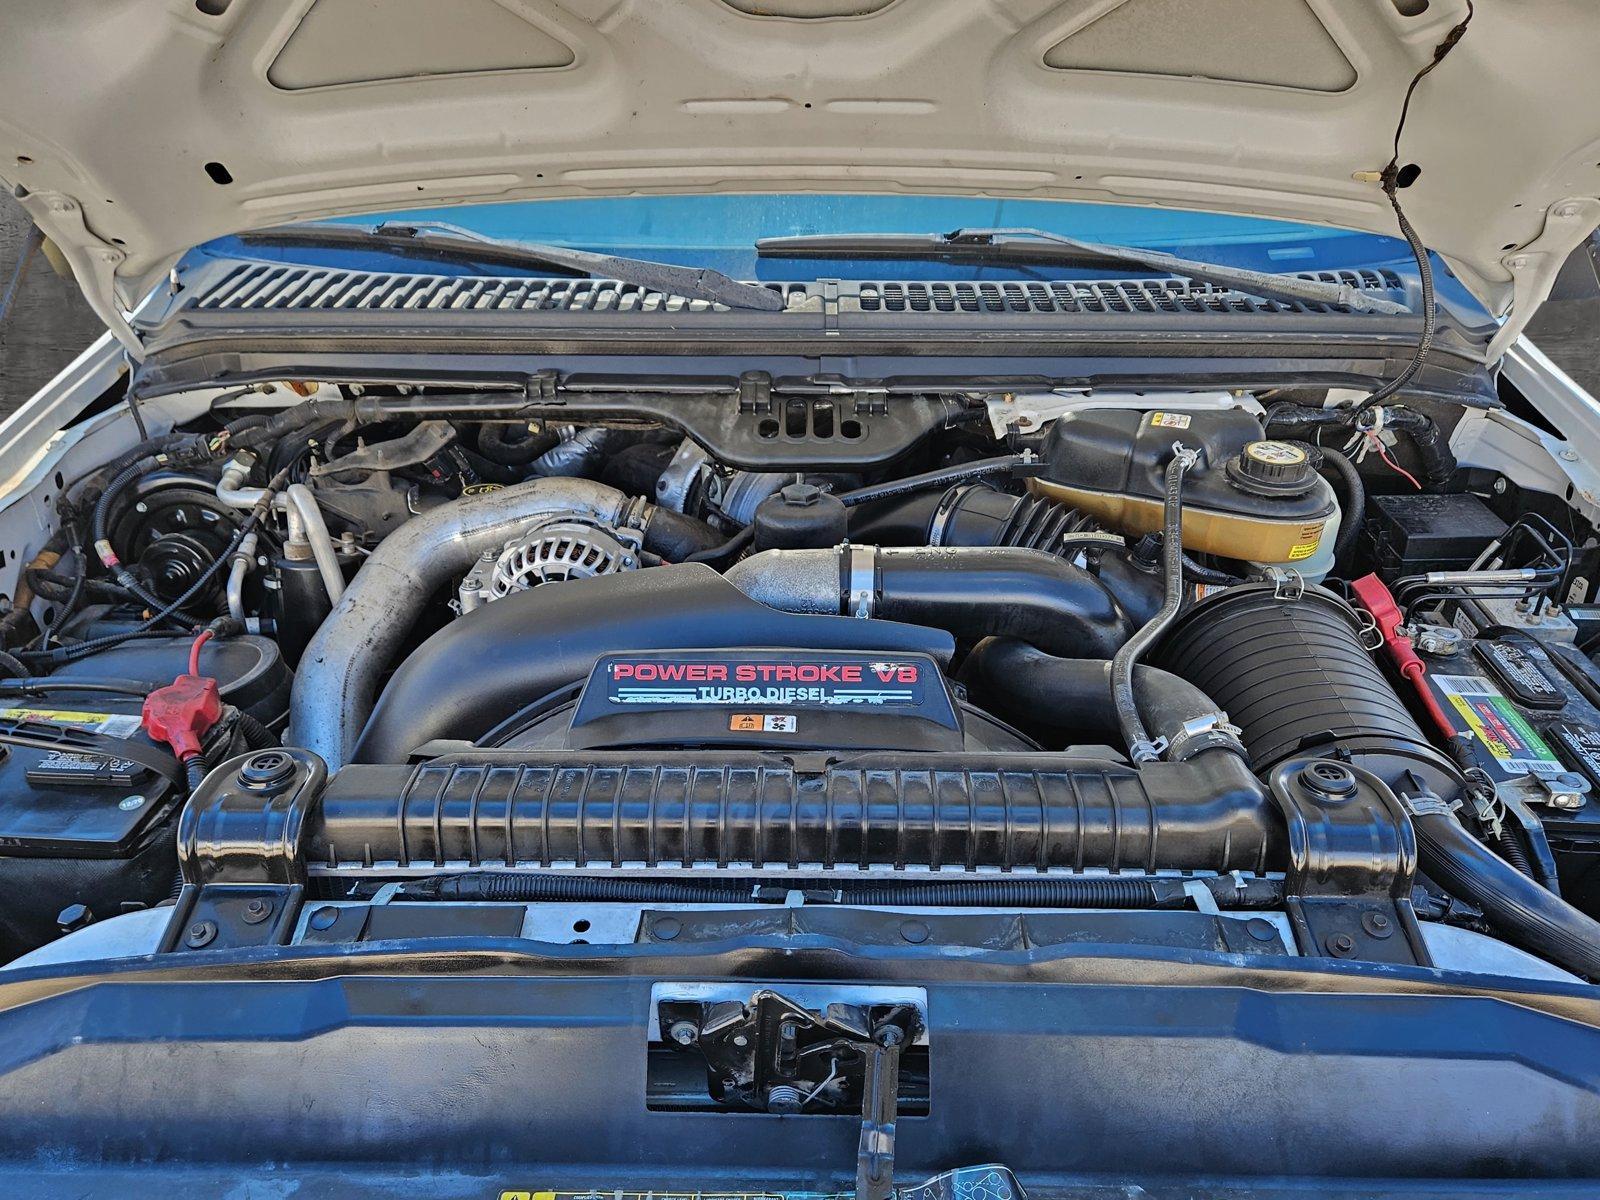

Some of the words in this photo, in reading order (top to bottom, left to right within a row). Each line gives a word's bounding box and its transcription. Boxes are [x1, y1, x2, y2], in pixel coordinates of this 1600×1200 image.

[614, 664, 728, 681] POWER
[736, 665, 862, 682] STROKE
[870, 664, 917, 683] V8
[698, 687, 760, 700] TURBO
[766, 687, 827, 702] DIESEL
